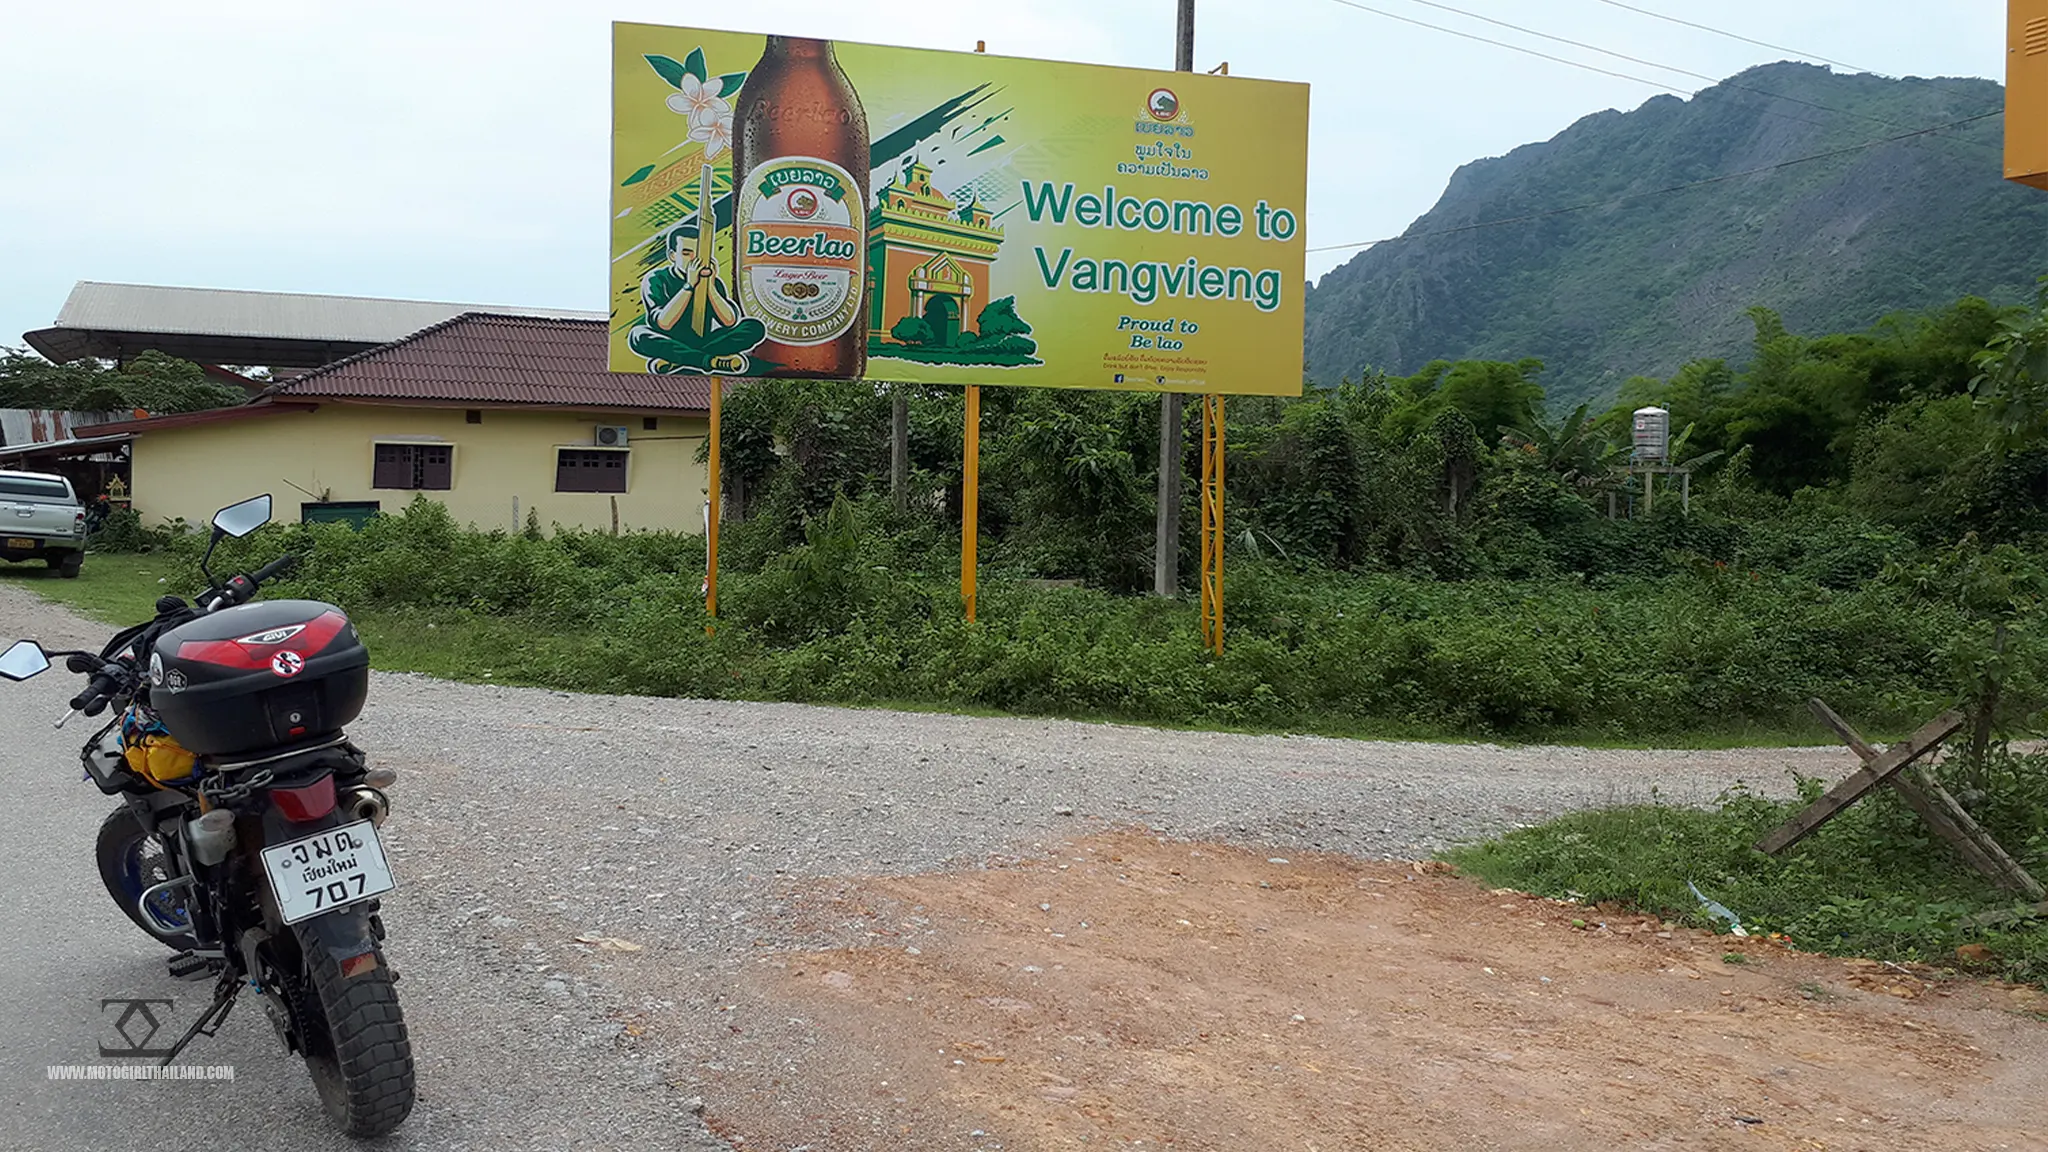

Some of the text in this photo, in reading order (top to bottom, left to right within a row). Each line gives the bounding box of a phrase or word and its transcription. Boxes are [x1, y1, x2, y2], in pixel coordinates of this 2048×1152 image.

[770, 169, 836, 189] ເບຍລາວ
[1022, 180, 1296, 240] Welcome to
[746, 229, 855, 260] Beerlao
[773, 269, 829, 280] Lager Beer
[1034, 246, 1281, 310] Vangvieng
[750, 303, 799, 336] BREWERY
[801, 306, 849, 337] COMPANY
[1118, 316, 1199, 333] Proud to
[1130, 335, 1183, 350] Be lao
[262, 630, 288, 642] GIVI
[302, 853, 358, 883] เชียงใหม่
[305, 873, 367, 909] 707
